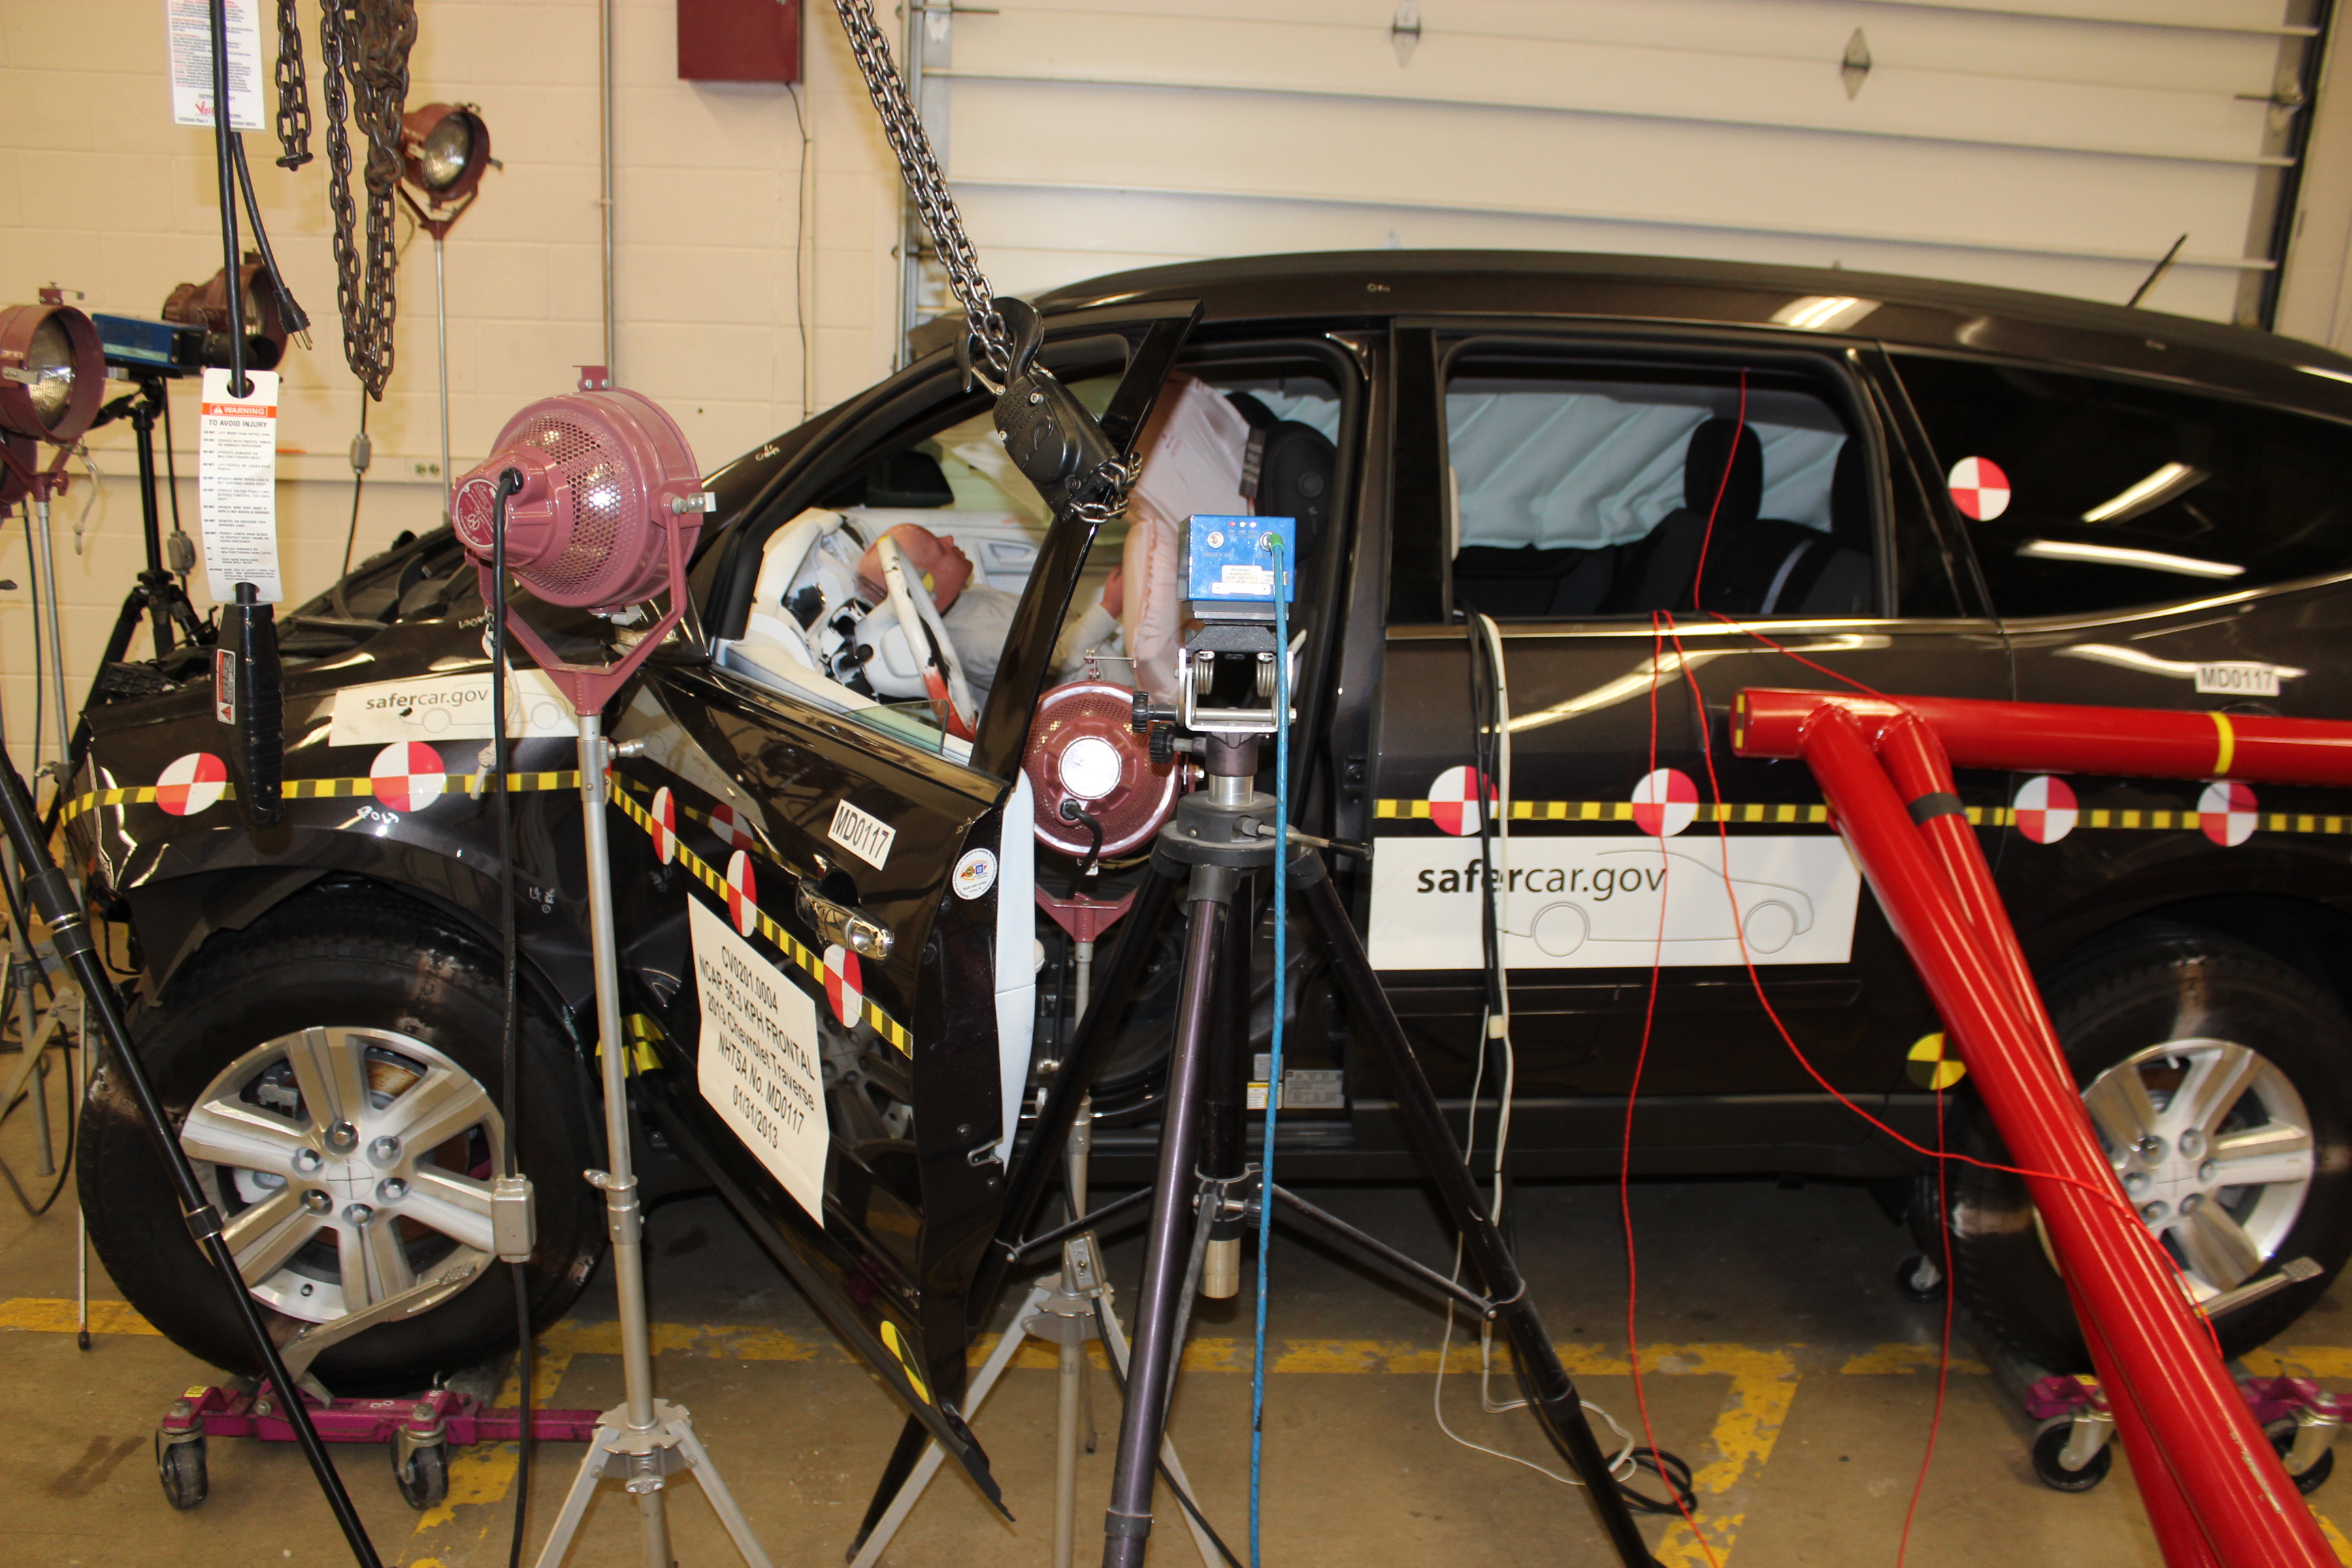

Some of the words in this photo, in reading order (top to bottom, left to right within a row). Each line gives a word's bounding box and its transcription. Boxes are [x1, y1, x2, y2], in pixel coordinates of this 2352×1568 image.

[224, 406, 265, 415] WARNING
[365, 689, 488, 709] safercar.gov
[2202, 667, 2273, 688] MD0117
[832, 806, 890, 859] MD0117
[1417, 859, 1666, 901] safercar.gov
[721, 945, 778, 1015] CV0201.0004
[699, 953, 722, 991] NCAP
[724, 979, 742, 1012] 56.3
[743, 996, 764, 1034] KPH
[765, 1016, 815, 1081] FRONTAL
[706, 991, 726, 1025] 2013
[727, 1011, 771, 1070] Chevrolet
[770, 1052, 815, 1111] Traverse
[718, 1031, 747, 1080] NHTSA
[749, 1063, 763, 1097] No.
[766, 1080, 805, 1135] MD0117
[733, 1084, 778, 1149] 01/31/2013
